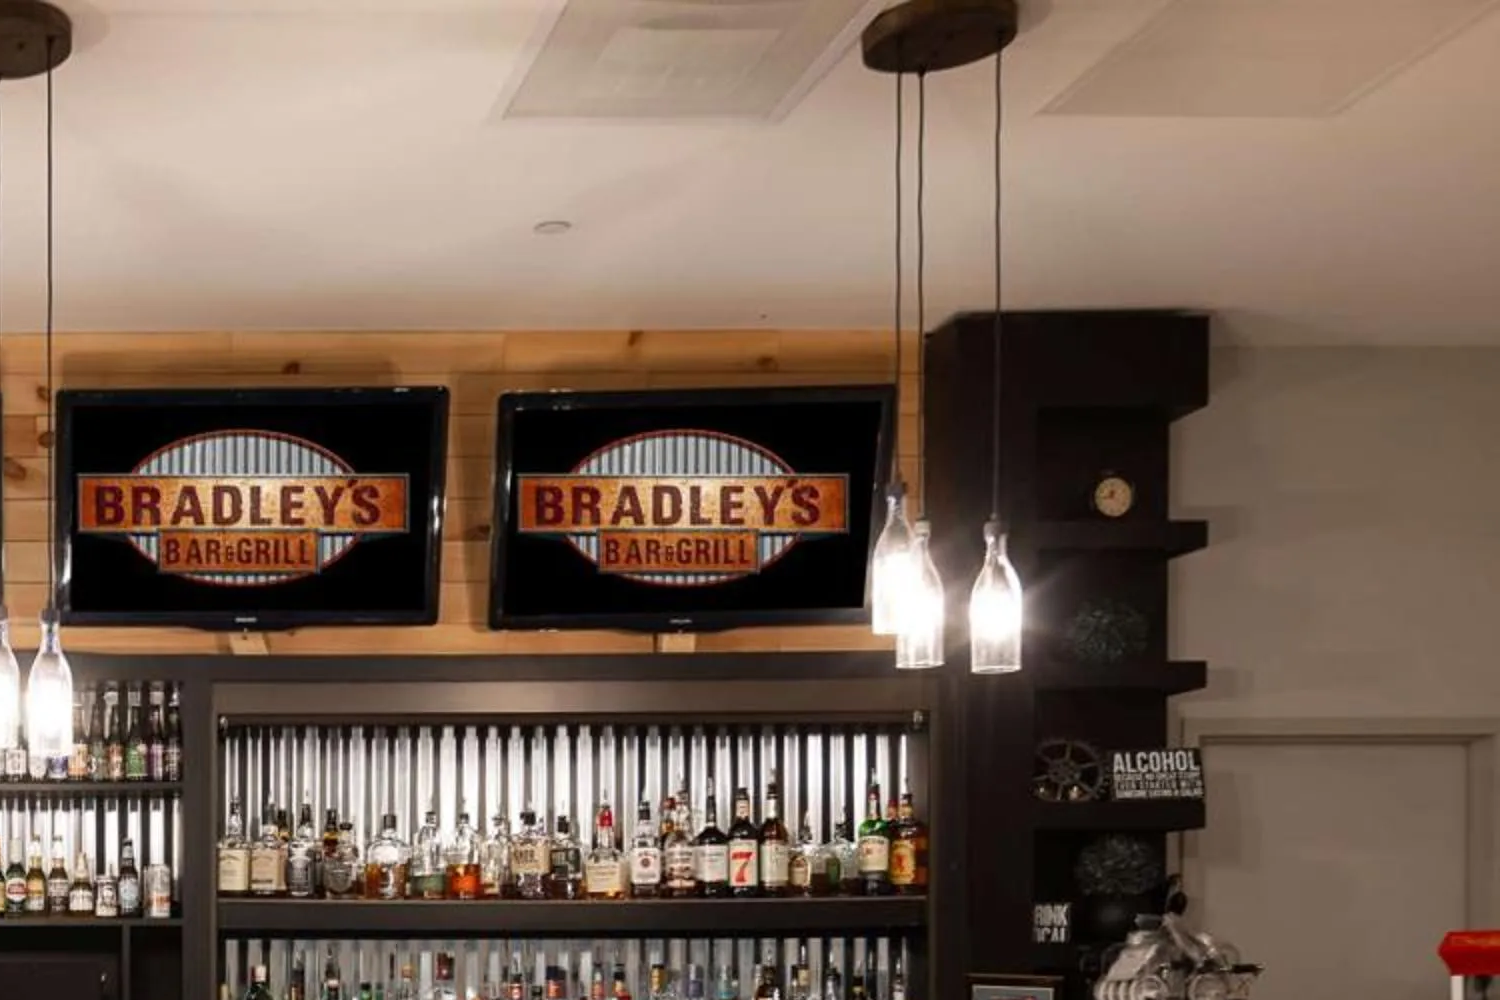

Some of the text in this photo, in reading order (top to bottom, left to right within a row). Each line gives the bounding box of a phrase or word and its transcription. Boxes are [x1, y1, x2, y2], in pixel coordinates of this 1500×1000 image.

[94, 479, 380, 527] BRADLEY'S
[535, 479, 820, 527] BRADLEY'S
[1113, 750, 1200, 773] ALCOHOL
[731, 850, 756, 883] 7
